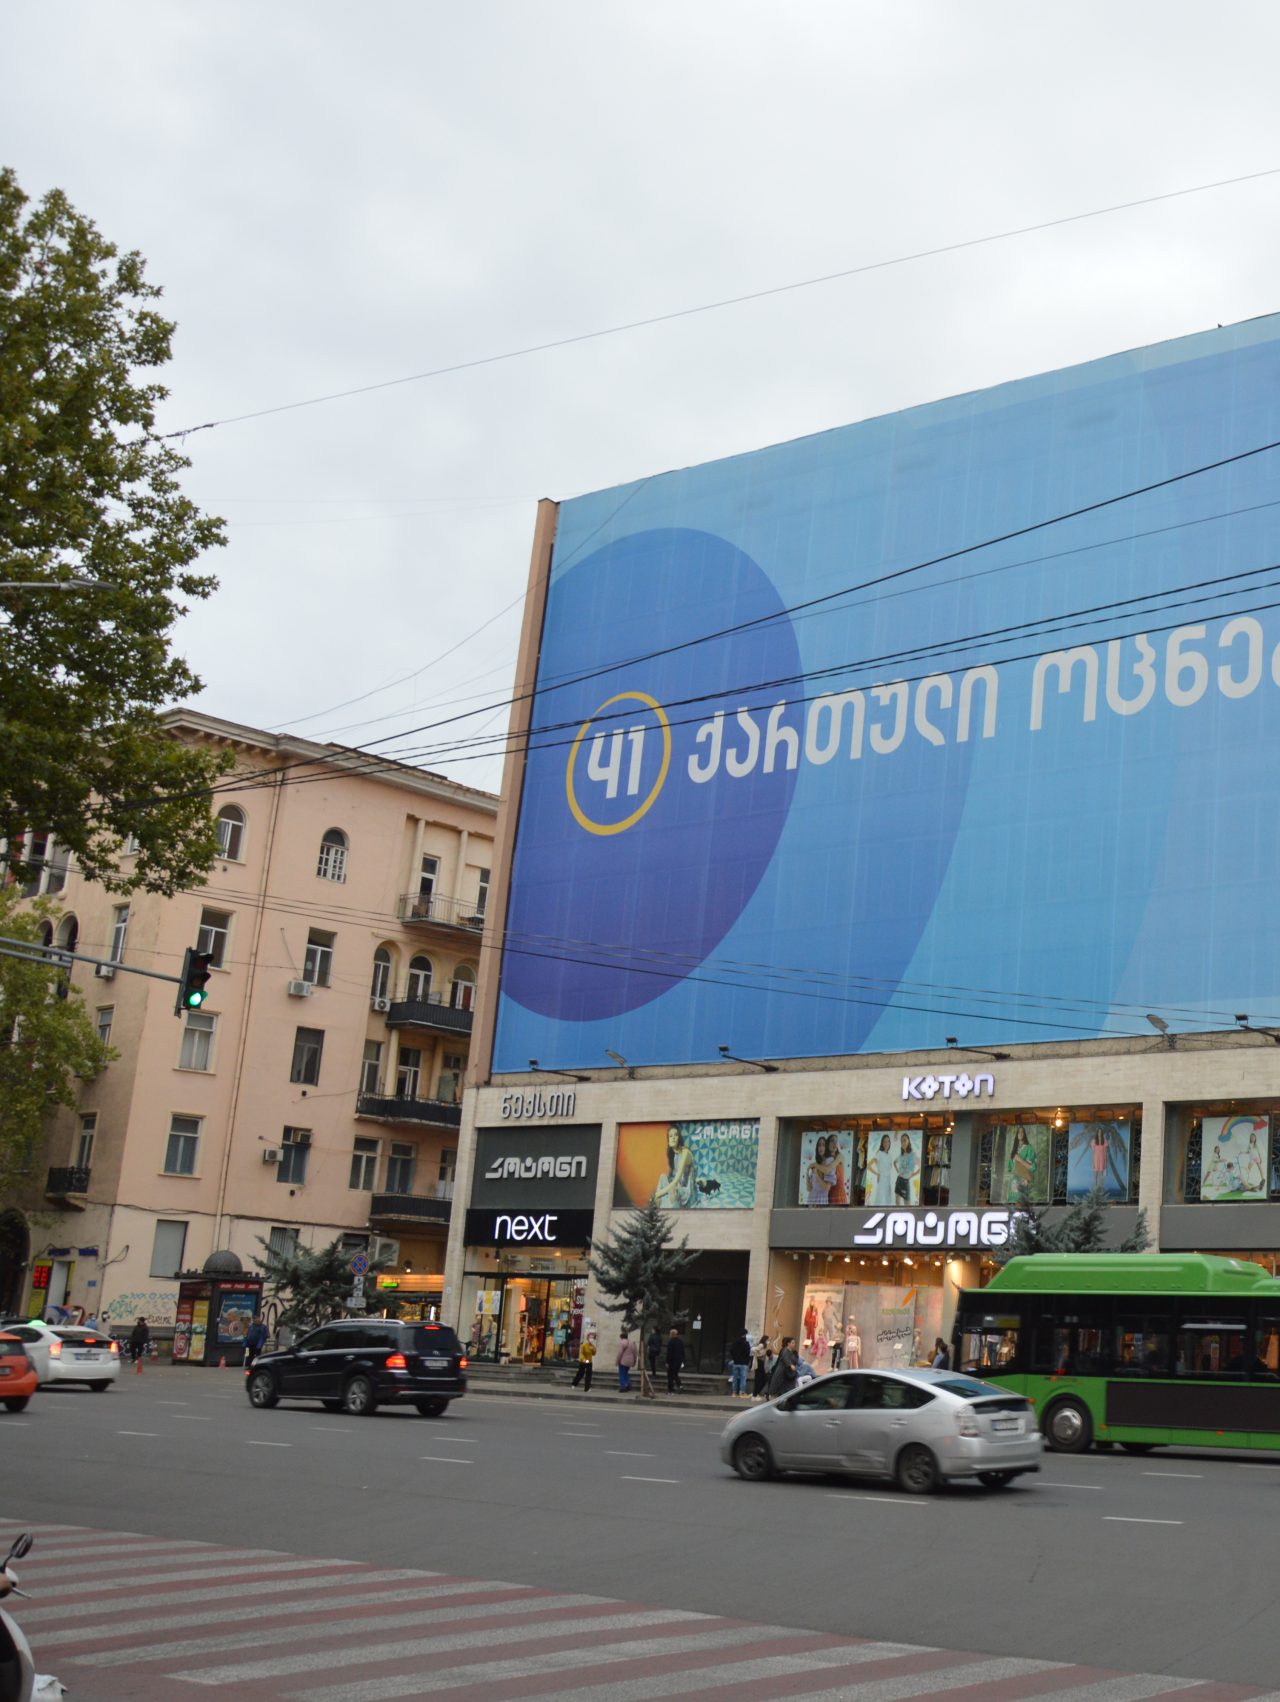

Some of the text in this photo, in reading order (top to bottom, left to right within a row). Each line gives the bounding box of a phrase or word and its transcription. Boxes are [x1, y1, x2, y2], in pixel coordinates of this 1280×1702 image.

[586, 726, 646, 800] 41
[687, 662, 1000, 784] ქართული
[500, 1091, 576, 1119] ნექსთი
[494, 1214, 558, 1241] next
